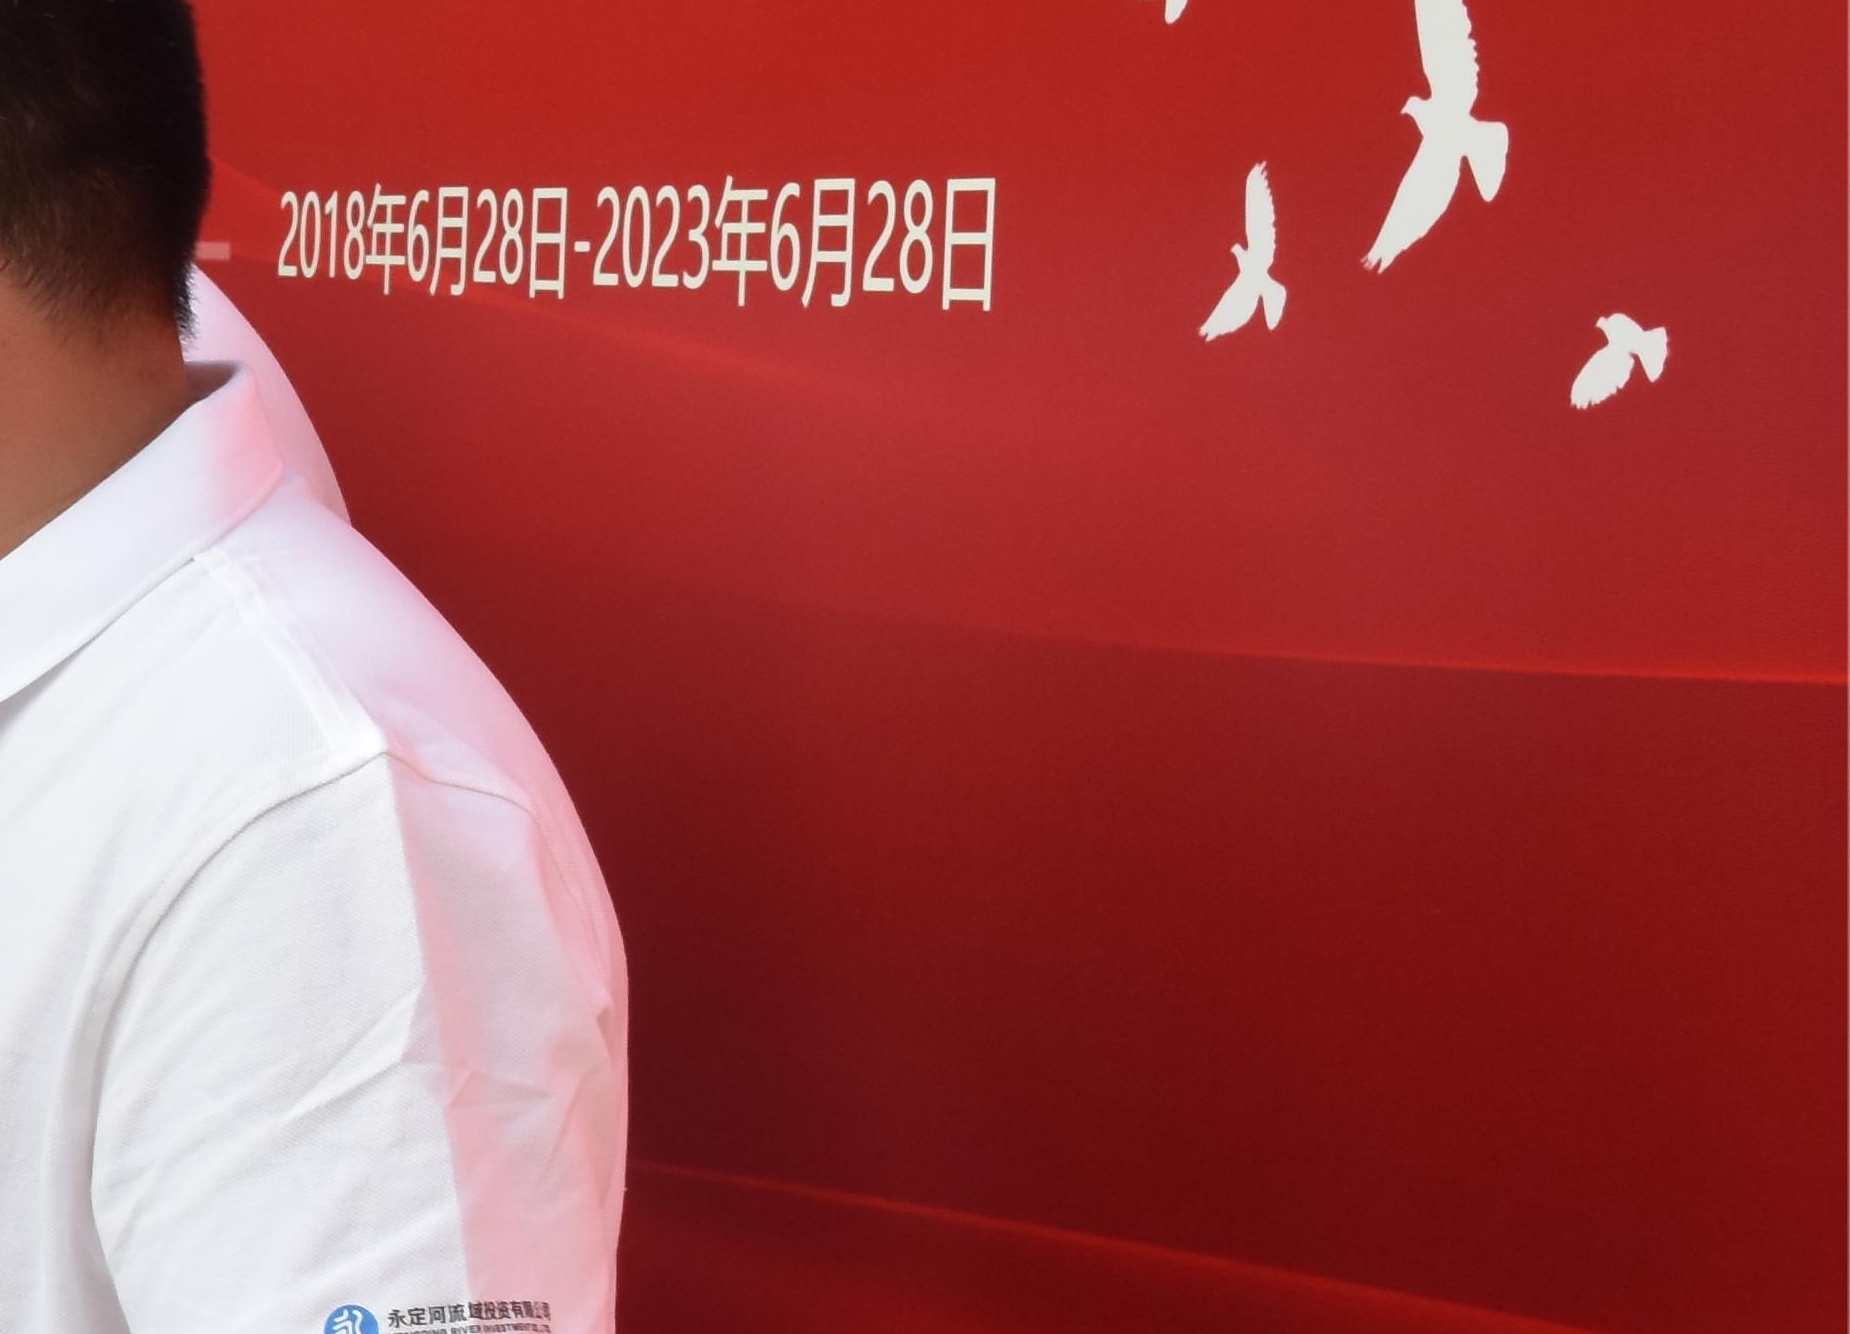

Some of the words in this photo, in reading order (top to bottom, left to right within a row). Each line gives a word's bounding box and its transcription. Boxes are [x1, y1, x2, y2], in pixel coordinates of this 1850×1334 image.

[276, 174, 997, 312] 2018年6月28日-2023年6月28日
